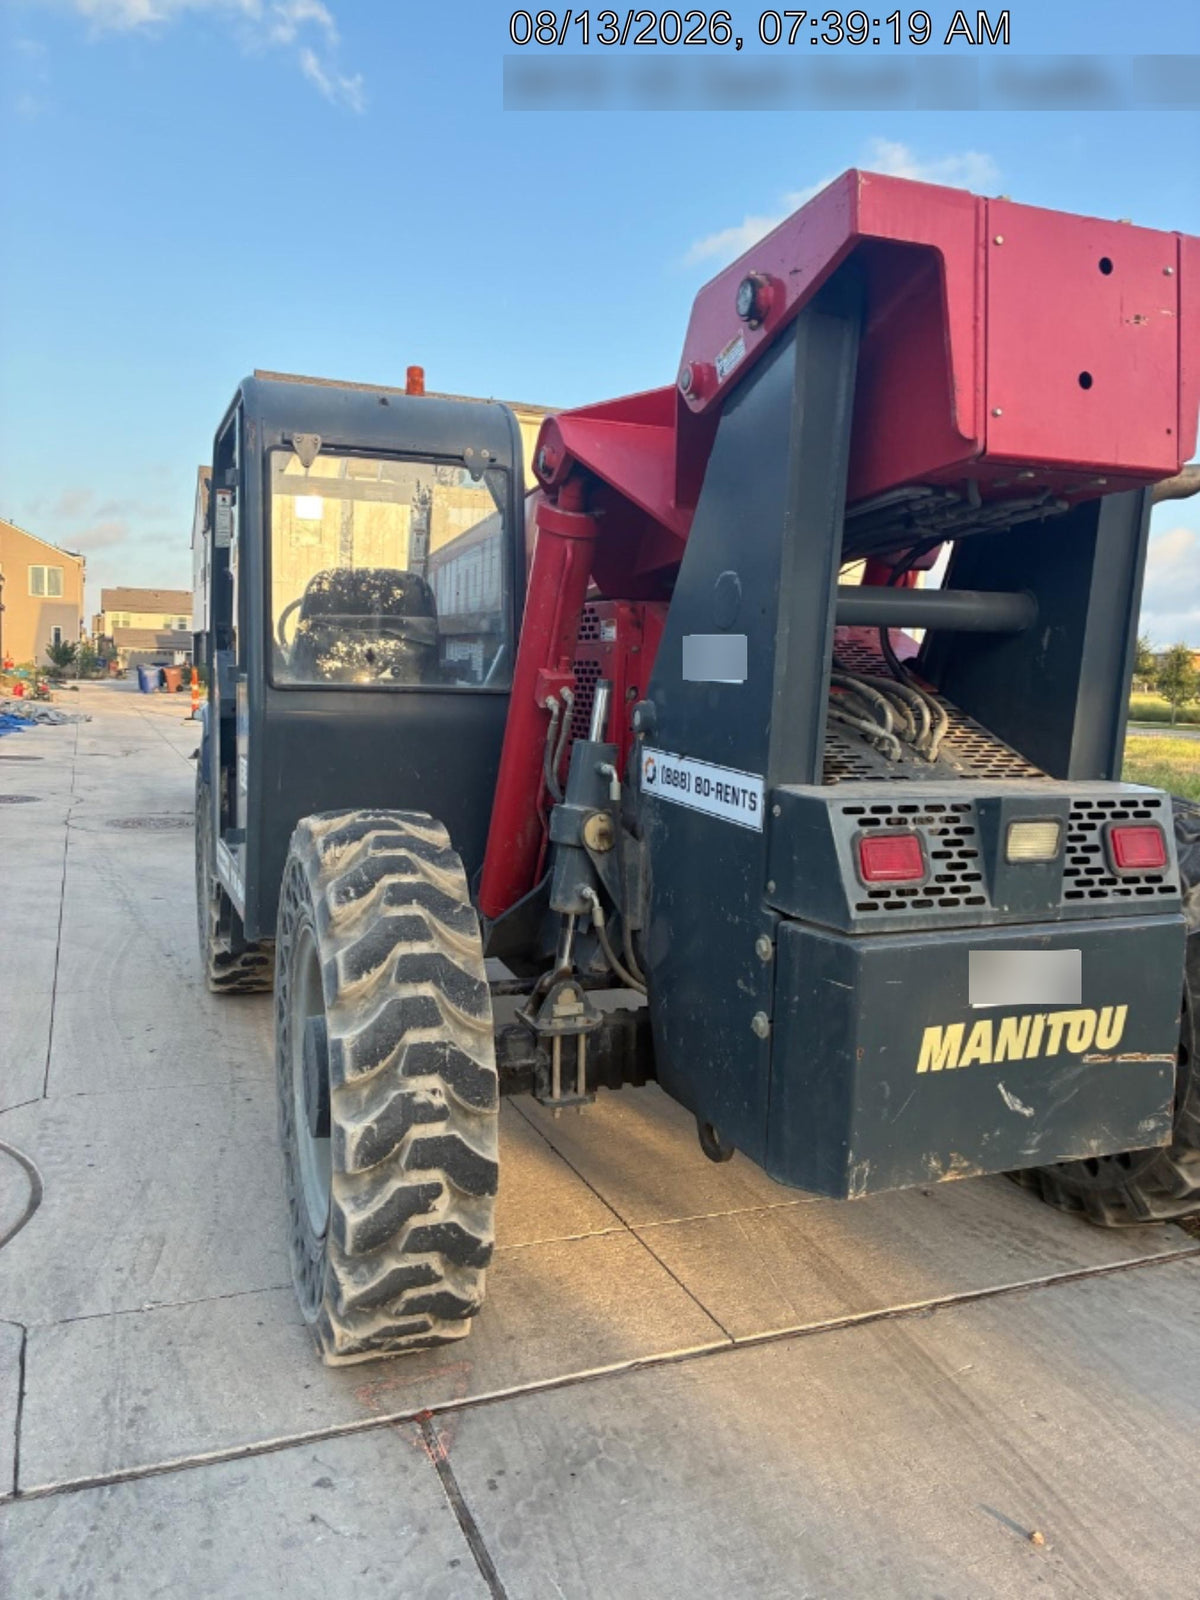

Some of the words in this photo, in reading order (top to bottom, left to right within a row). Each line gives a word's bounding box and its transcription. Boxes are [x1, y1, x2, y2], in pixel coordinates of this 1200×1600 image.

[661, 764, 692, 793] (888)
[694, 776, 758, 812] 80-RENTS
[916, 1004, 1128, 1074] MANITOU
